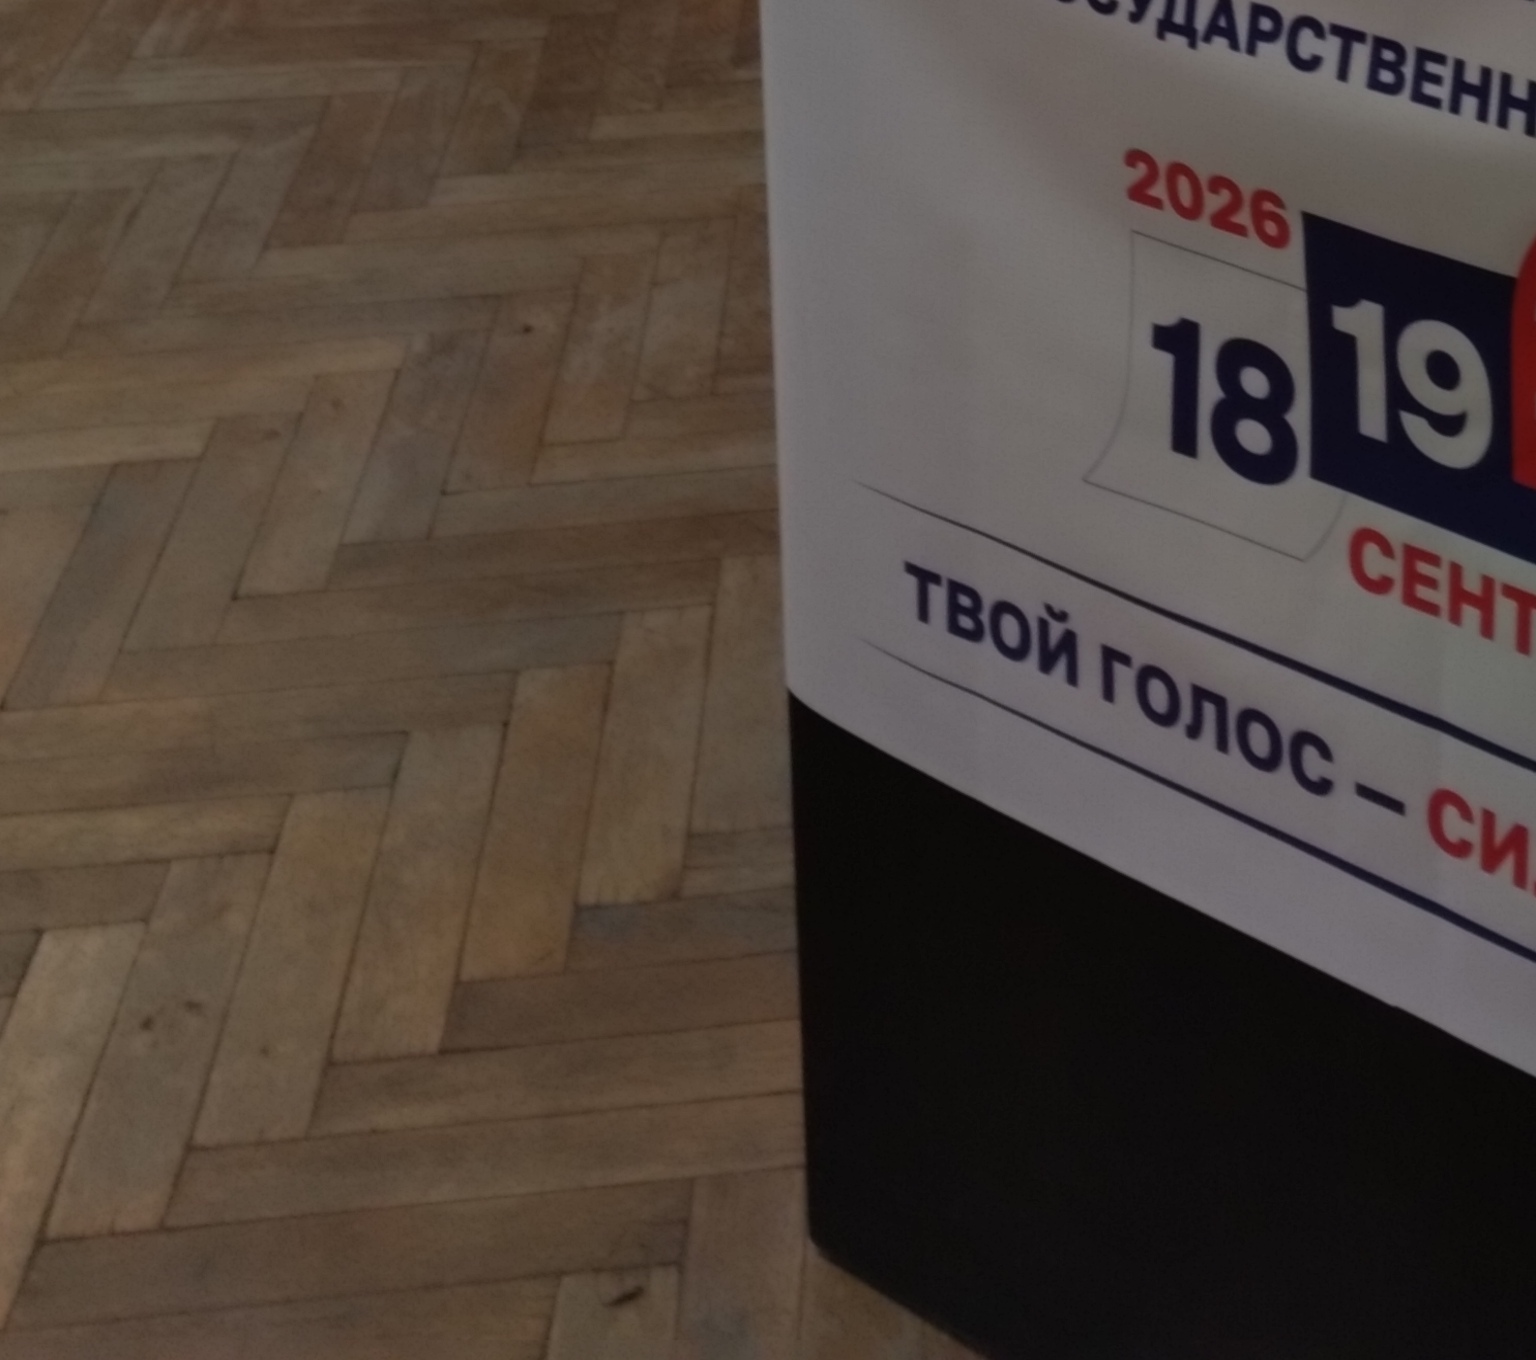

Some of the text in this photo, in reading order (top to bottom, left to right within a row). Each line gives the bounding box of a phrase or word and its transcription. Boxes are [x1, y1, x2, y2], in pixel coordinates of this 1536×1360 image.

[1123, 148, 1292, 251] 2026
[1151, 317, 1299, 486] 18
[1331, 298, 1492, 470] 19
[903, 560, 1080, 689] ТВОЙ
[1099, 641, 1336, 798] ГОЛОС
